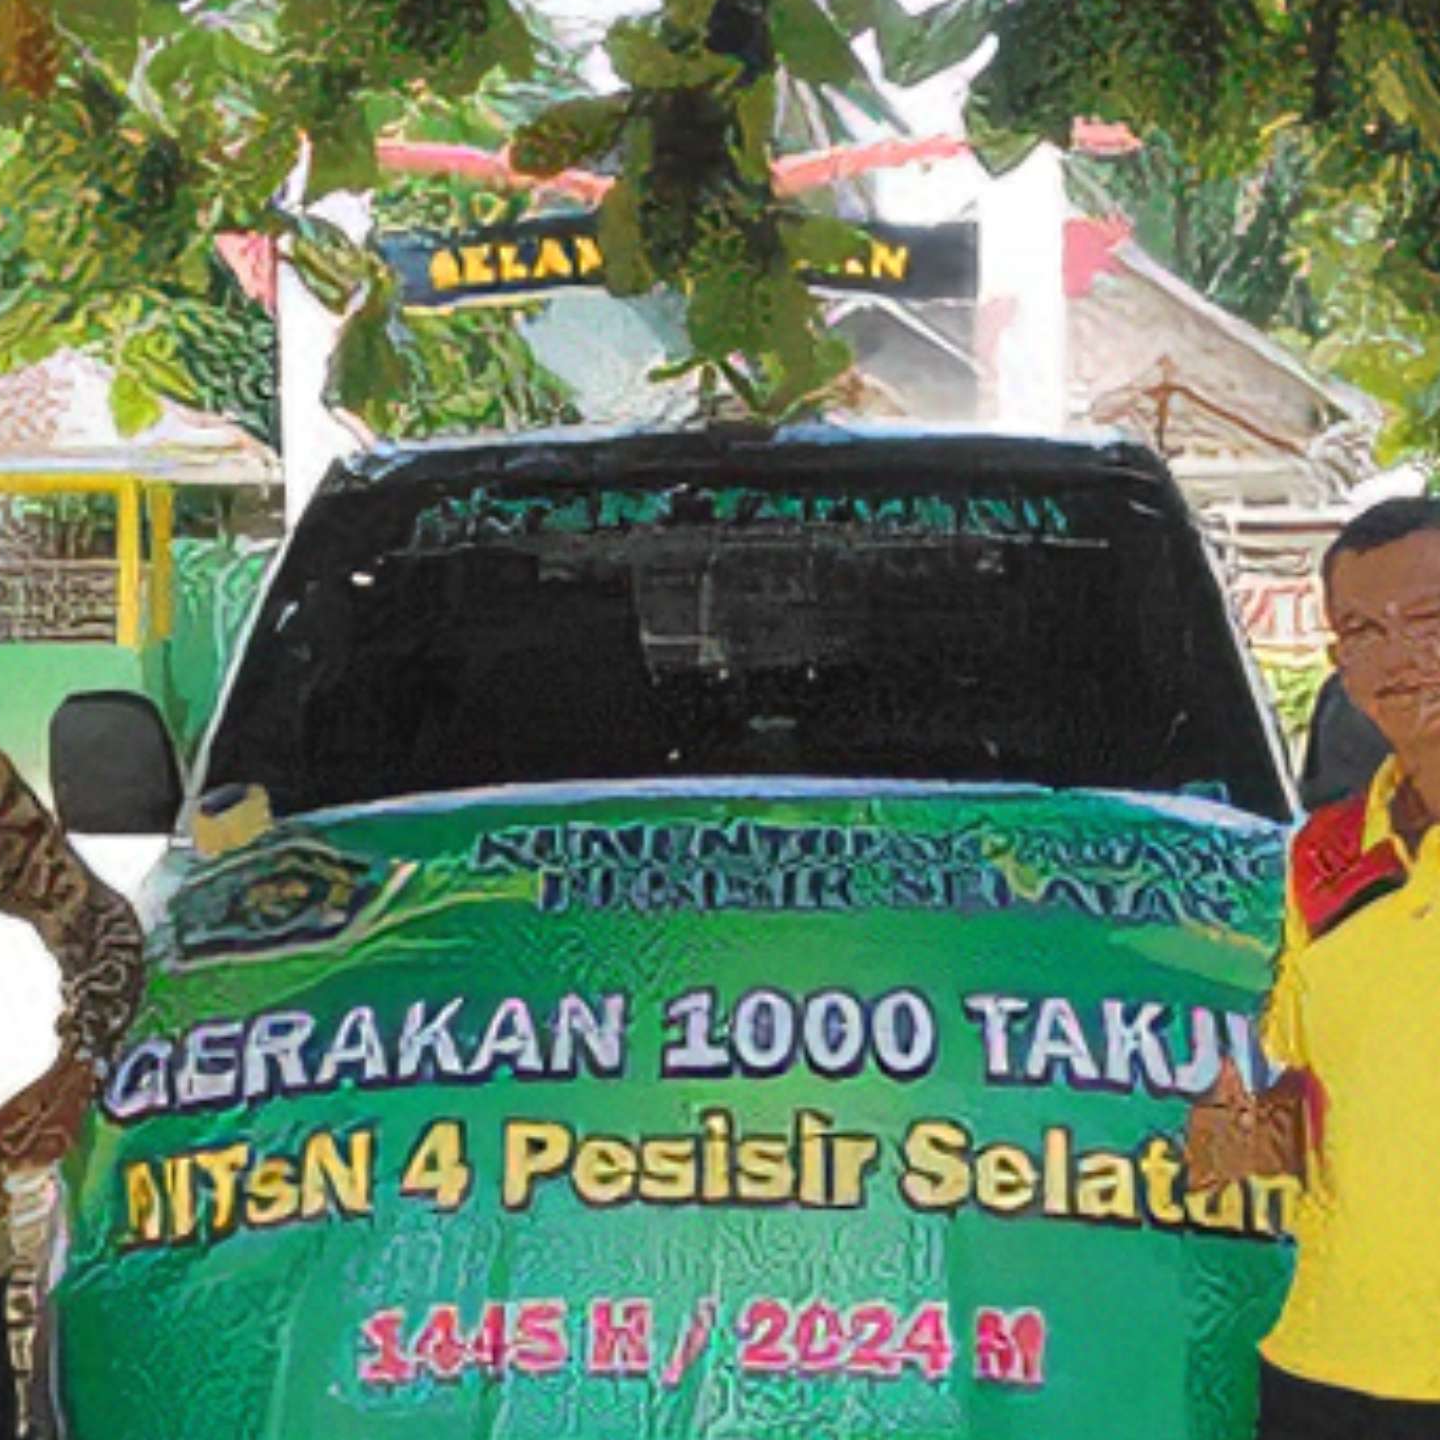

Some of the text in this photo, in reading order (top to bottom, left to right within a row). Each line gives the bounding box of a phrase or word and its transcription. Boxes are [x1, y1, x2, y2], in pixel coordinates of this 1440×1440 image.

[98, 990, 628, 1126] GERAKAN
[661, 986, 938, 1081] 1000
[398, 1118, 472, 1215] 4
[500, 1110, 878, 1210] Pesisir
[359, 1300, 567, 1383] 1445
[740, 1298, 952, 1378] 2024
